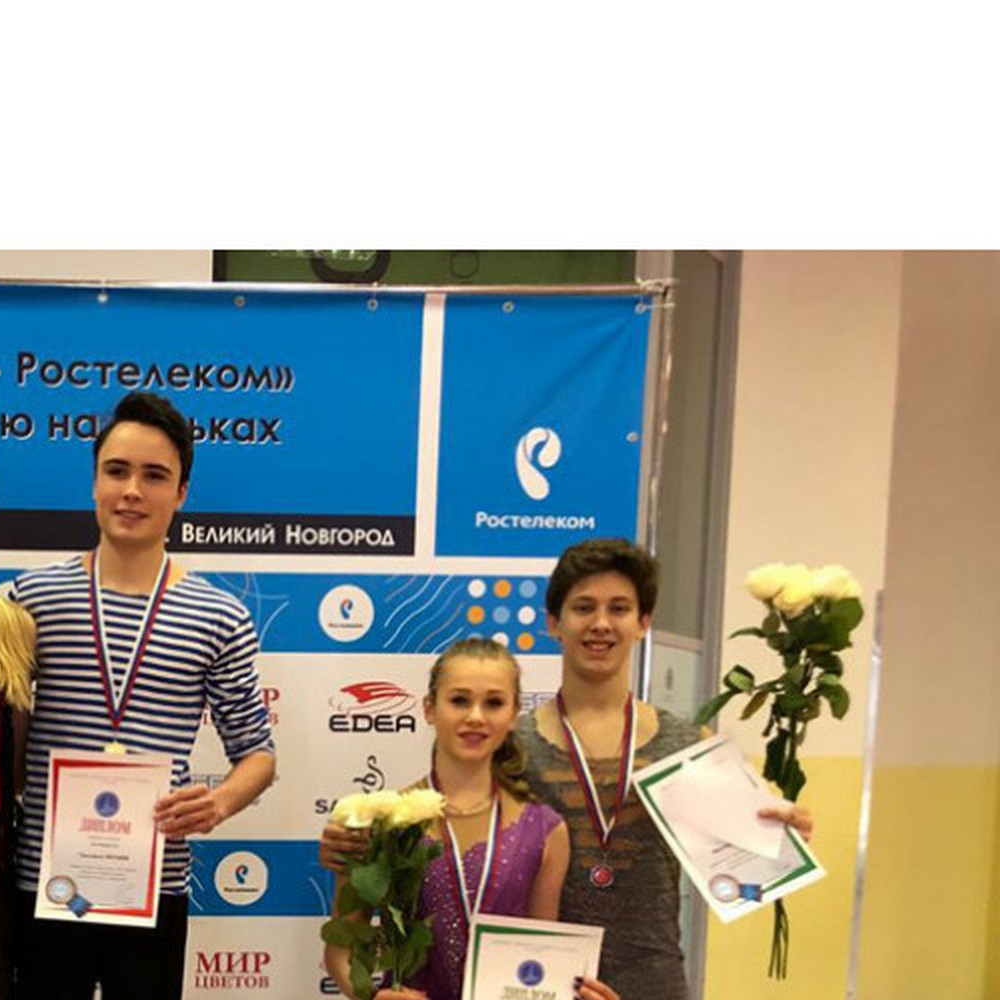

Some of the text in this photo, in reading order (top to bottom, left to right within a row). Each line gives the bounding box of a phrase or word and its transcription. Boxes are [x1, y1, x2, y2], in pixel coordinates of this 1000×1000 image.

[17, 351, 296, 393] Ростелеком»
[49, 413, 99, 440] на
[475, 511, 595, 530] Ростелеком
[181, 522, 396, 547] ВЕЛИКИЙ НОВГОРОД
[329, 714, 416, 733] EDEA
[196, 951, 271, 973] МИР
[195, 976, 270, 990] ЦВЕТОВ
